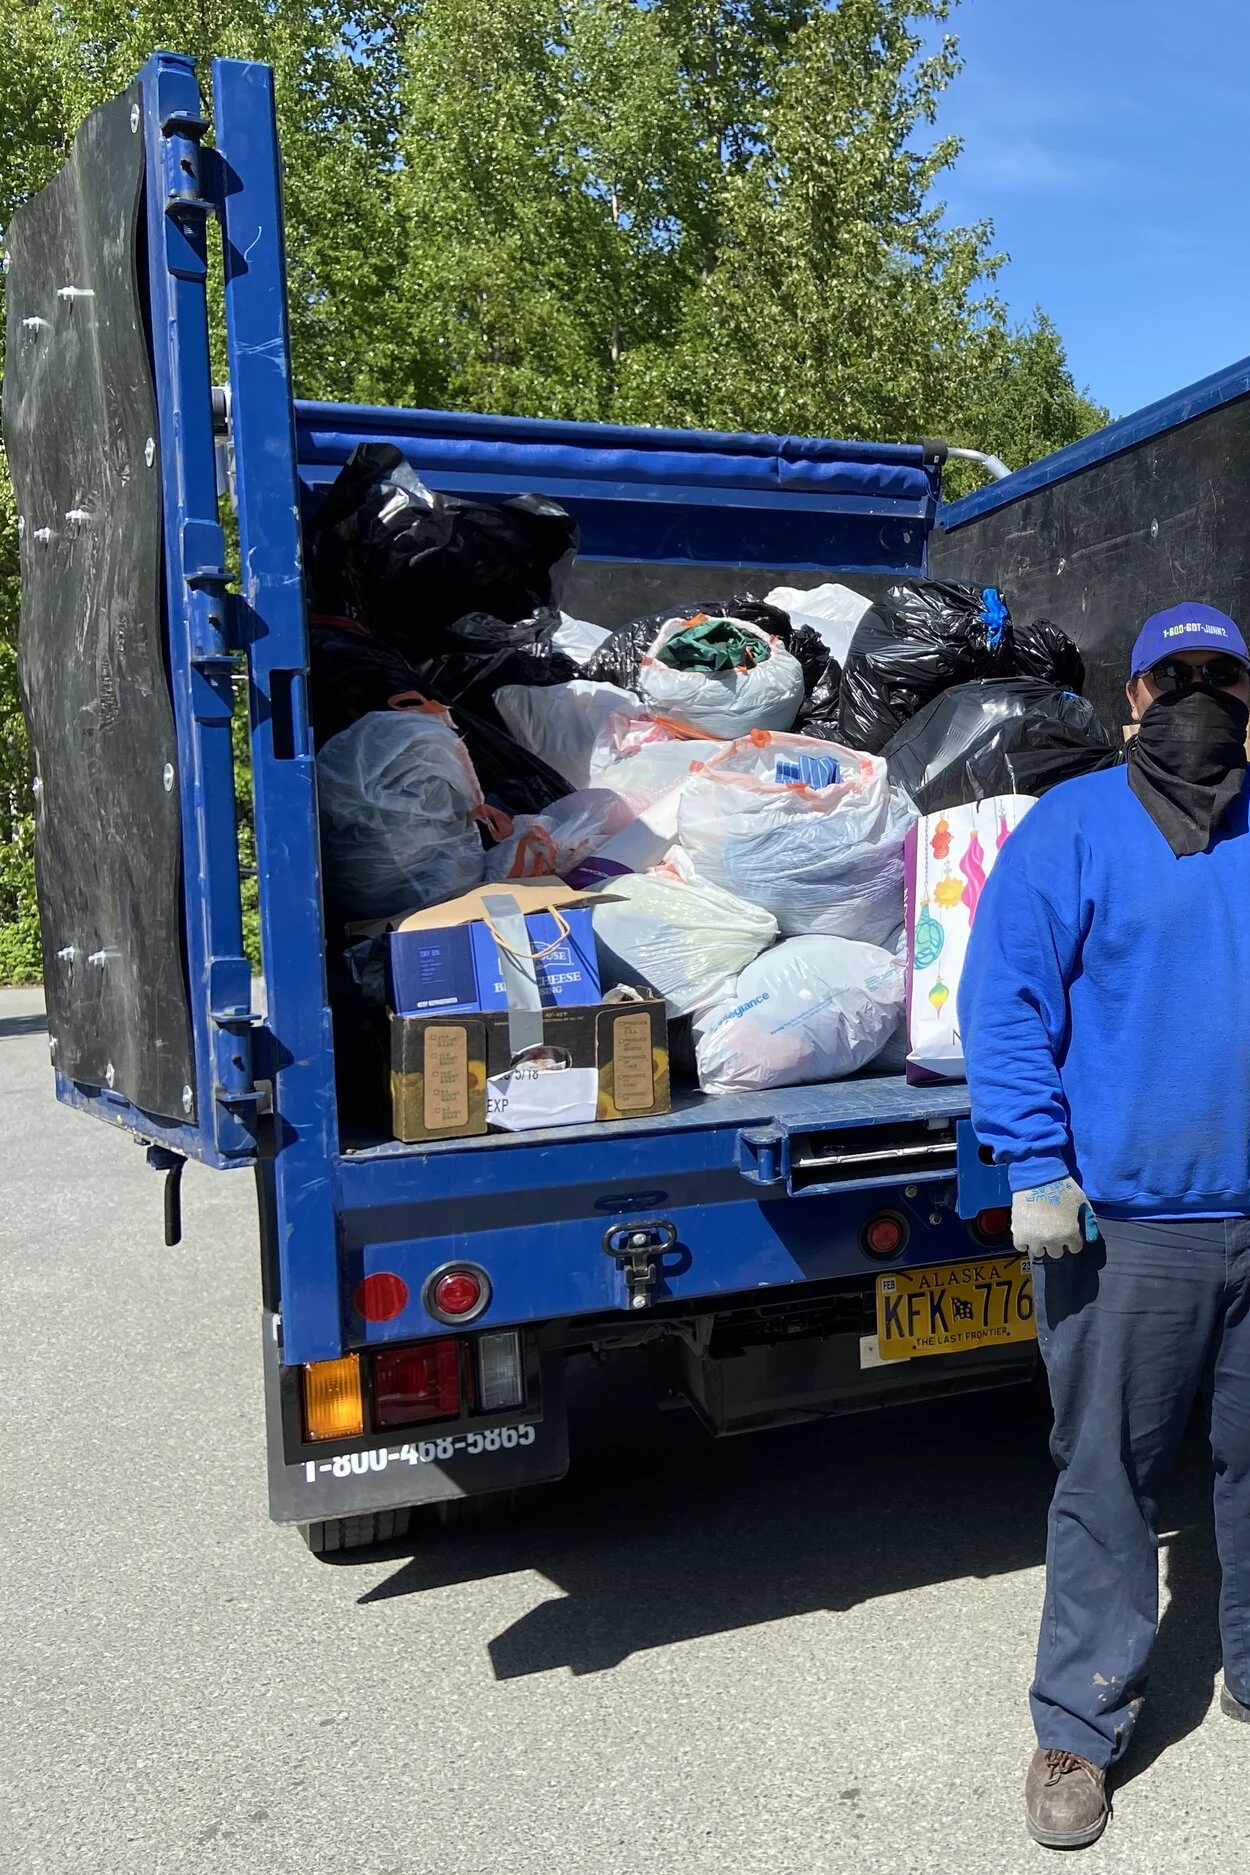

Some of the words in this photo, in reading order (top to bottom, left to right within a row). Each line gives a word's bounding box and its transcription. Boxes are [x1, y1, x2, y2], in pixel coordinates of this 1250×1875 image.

[1162, 622, 1229, 638] 1-800-GOT-JUNK?
[486, 1098, 509, 1113] EXP
[882, 1279, 896, 1290] FEB
[919, 1265, 1001, 1289] ALASKA
[884, 1289, 949, 1340] KFK
[975, 1278, 1034, 1327] 776
[916, 1337, 934, 1347] THE
[937, 1334, 962, 1345] LAST
[965, 1327, 1007, 1340] FRONTIER
